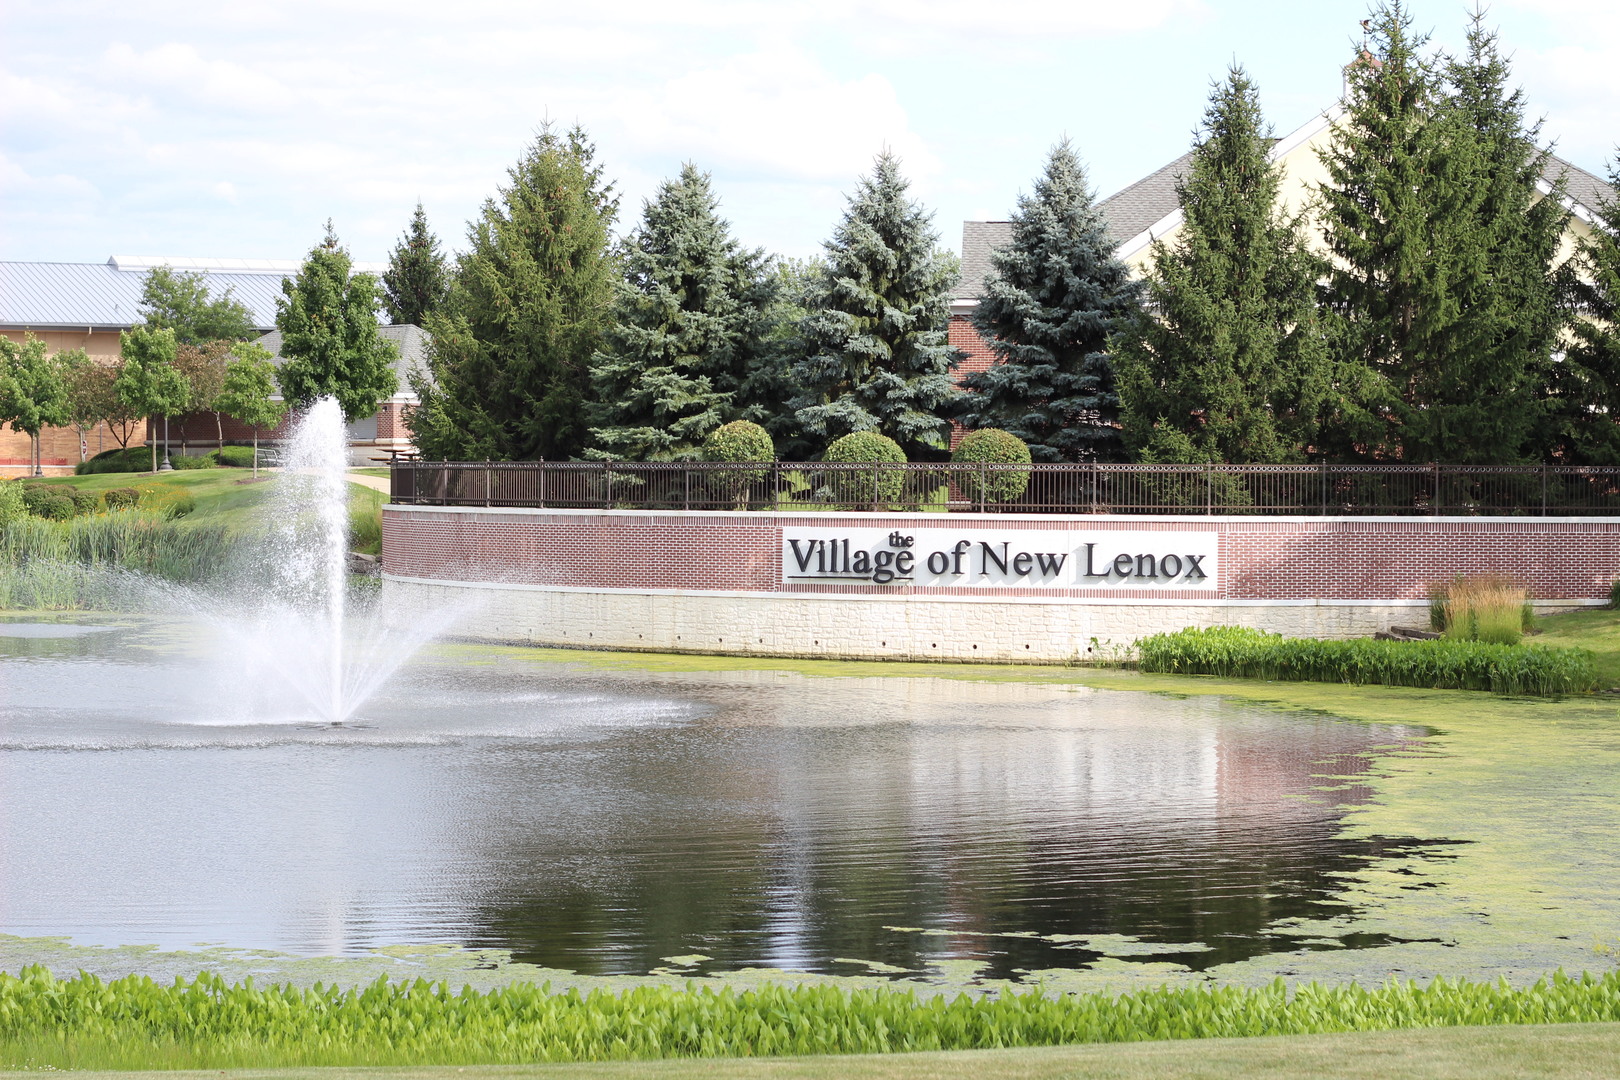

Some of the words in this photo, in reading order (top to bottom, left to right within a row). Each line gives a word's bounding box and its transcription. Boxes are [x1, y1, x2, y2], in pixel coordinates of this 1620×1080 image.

[888, 530, 915, 549] the
[787, 538, 915, 584] Village
[927, 539, 971, 575] of
[978, 541, 1068, 577] New
[1083, 543, 1208, 579] Lenox
